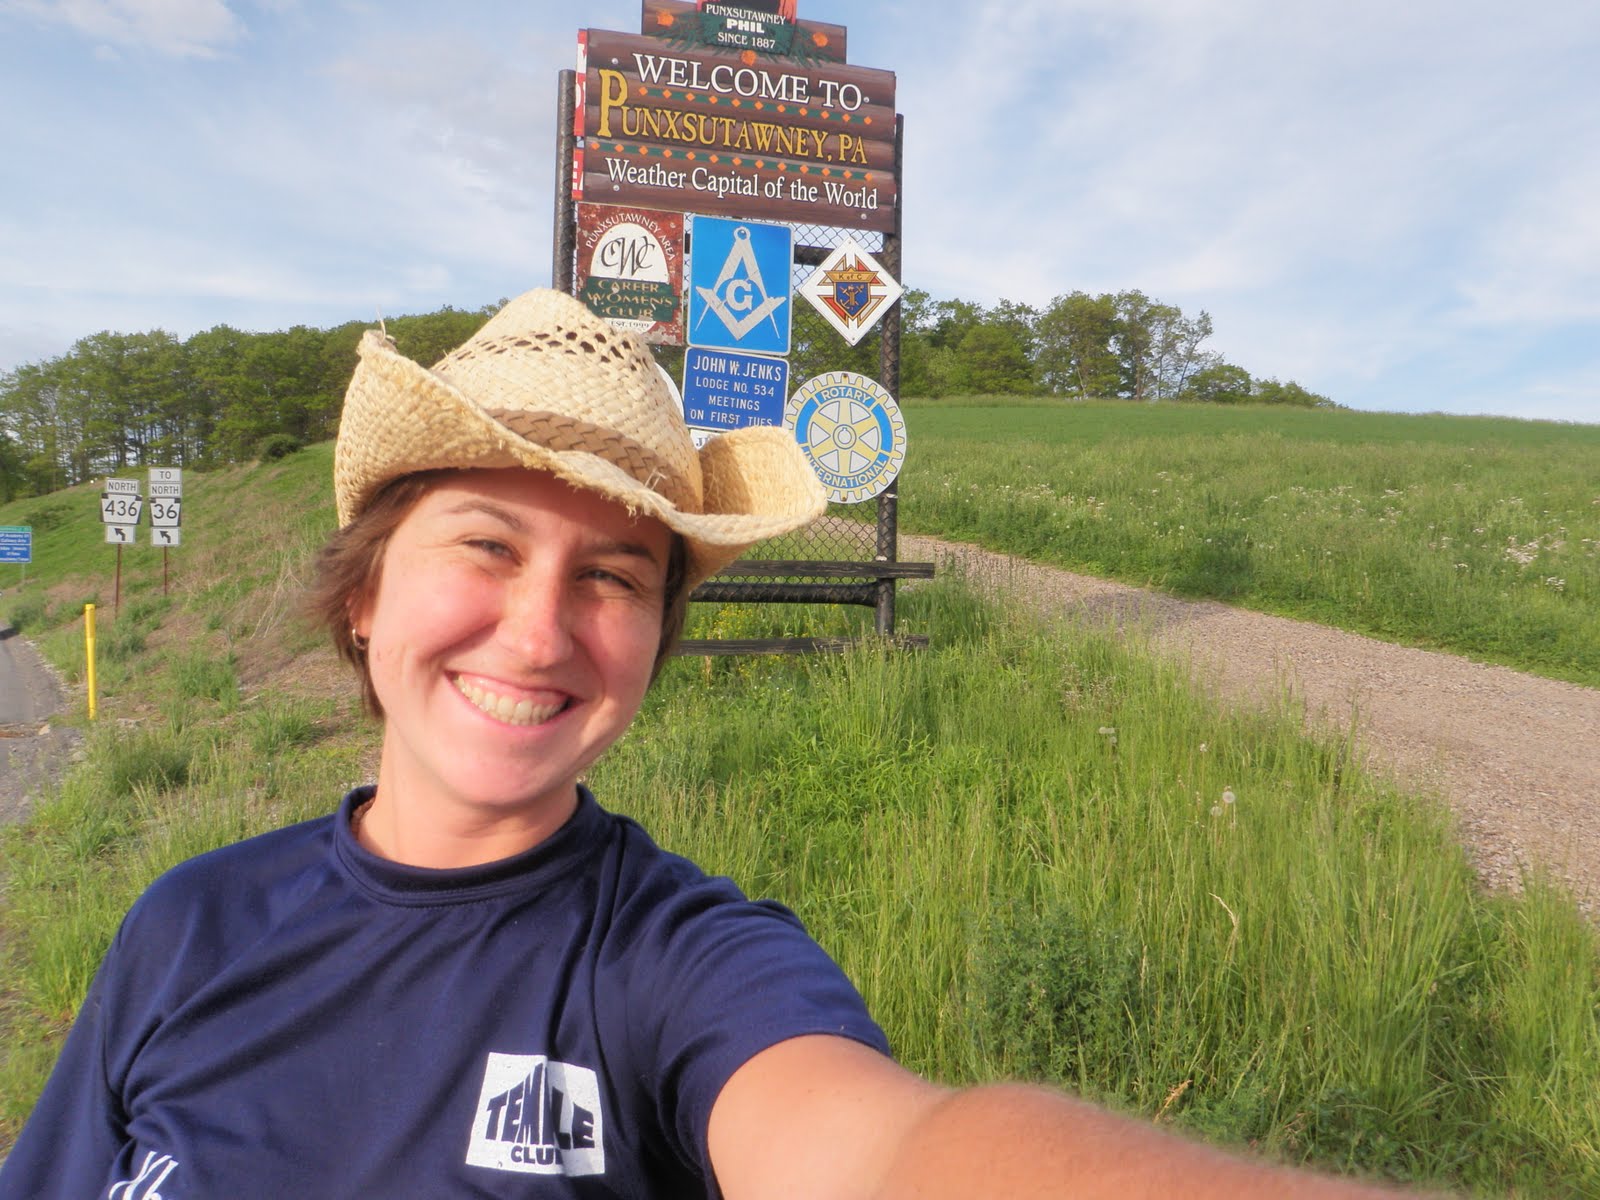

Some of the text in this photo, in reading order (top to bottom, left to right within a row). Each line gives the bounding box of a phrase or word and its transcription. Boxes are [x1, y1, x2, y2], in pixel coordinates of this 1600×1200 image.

[706, 4, 786, 25] PUNXSUTAWNEY
[726, 18, 765, 34] PHIL
[717, 31, 776, 49] SINCE 1887
[632, 53, 862, 111] WELCOME TO
[839, 134, 868, 164] PA
[605, 157, 878, 210] Weather Capital of the World
[585, 213, 676, 261] PUNXSUTAWNEY AREA
[598, 279, 659, 293] CAREER
[726, 279, 753, 311] G
[693, 355, 782, 382] JOHN W. JENKS
[695, 376, 774, 397] LODGE NO. 534
[708, 395, 760, 411] MEETINGS
[821, 387, 871, 404] ROTARY
[690, 409, 704, 420] ON
[710, 411, 740, 425] FIRST
[159, 471, 172, 480] TO
[108, 481, 137, 491] NORTH
[151, 486, 179, 495] NORTH
[105, 500, 137, 517] 436
[153, 503, 178, 519] 36
